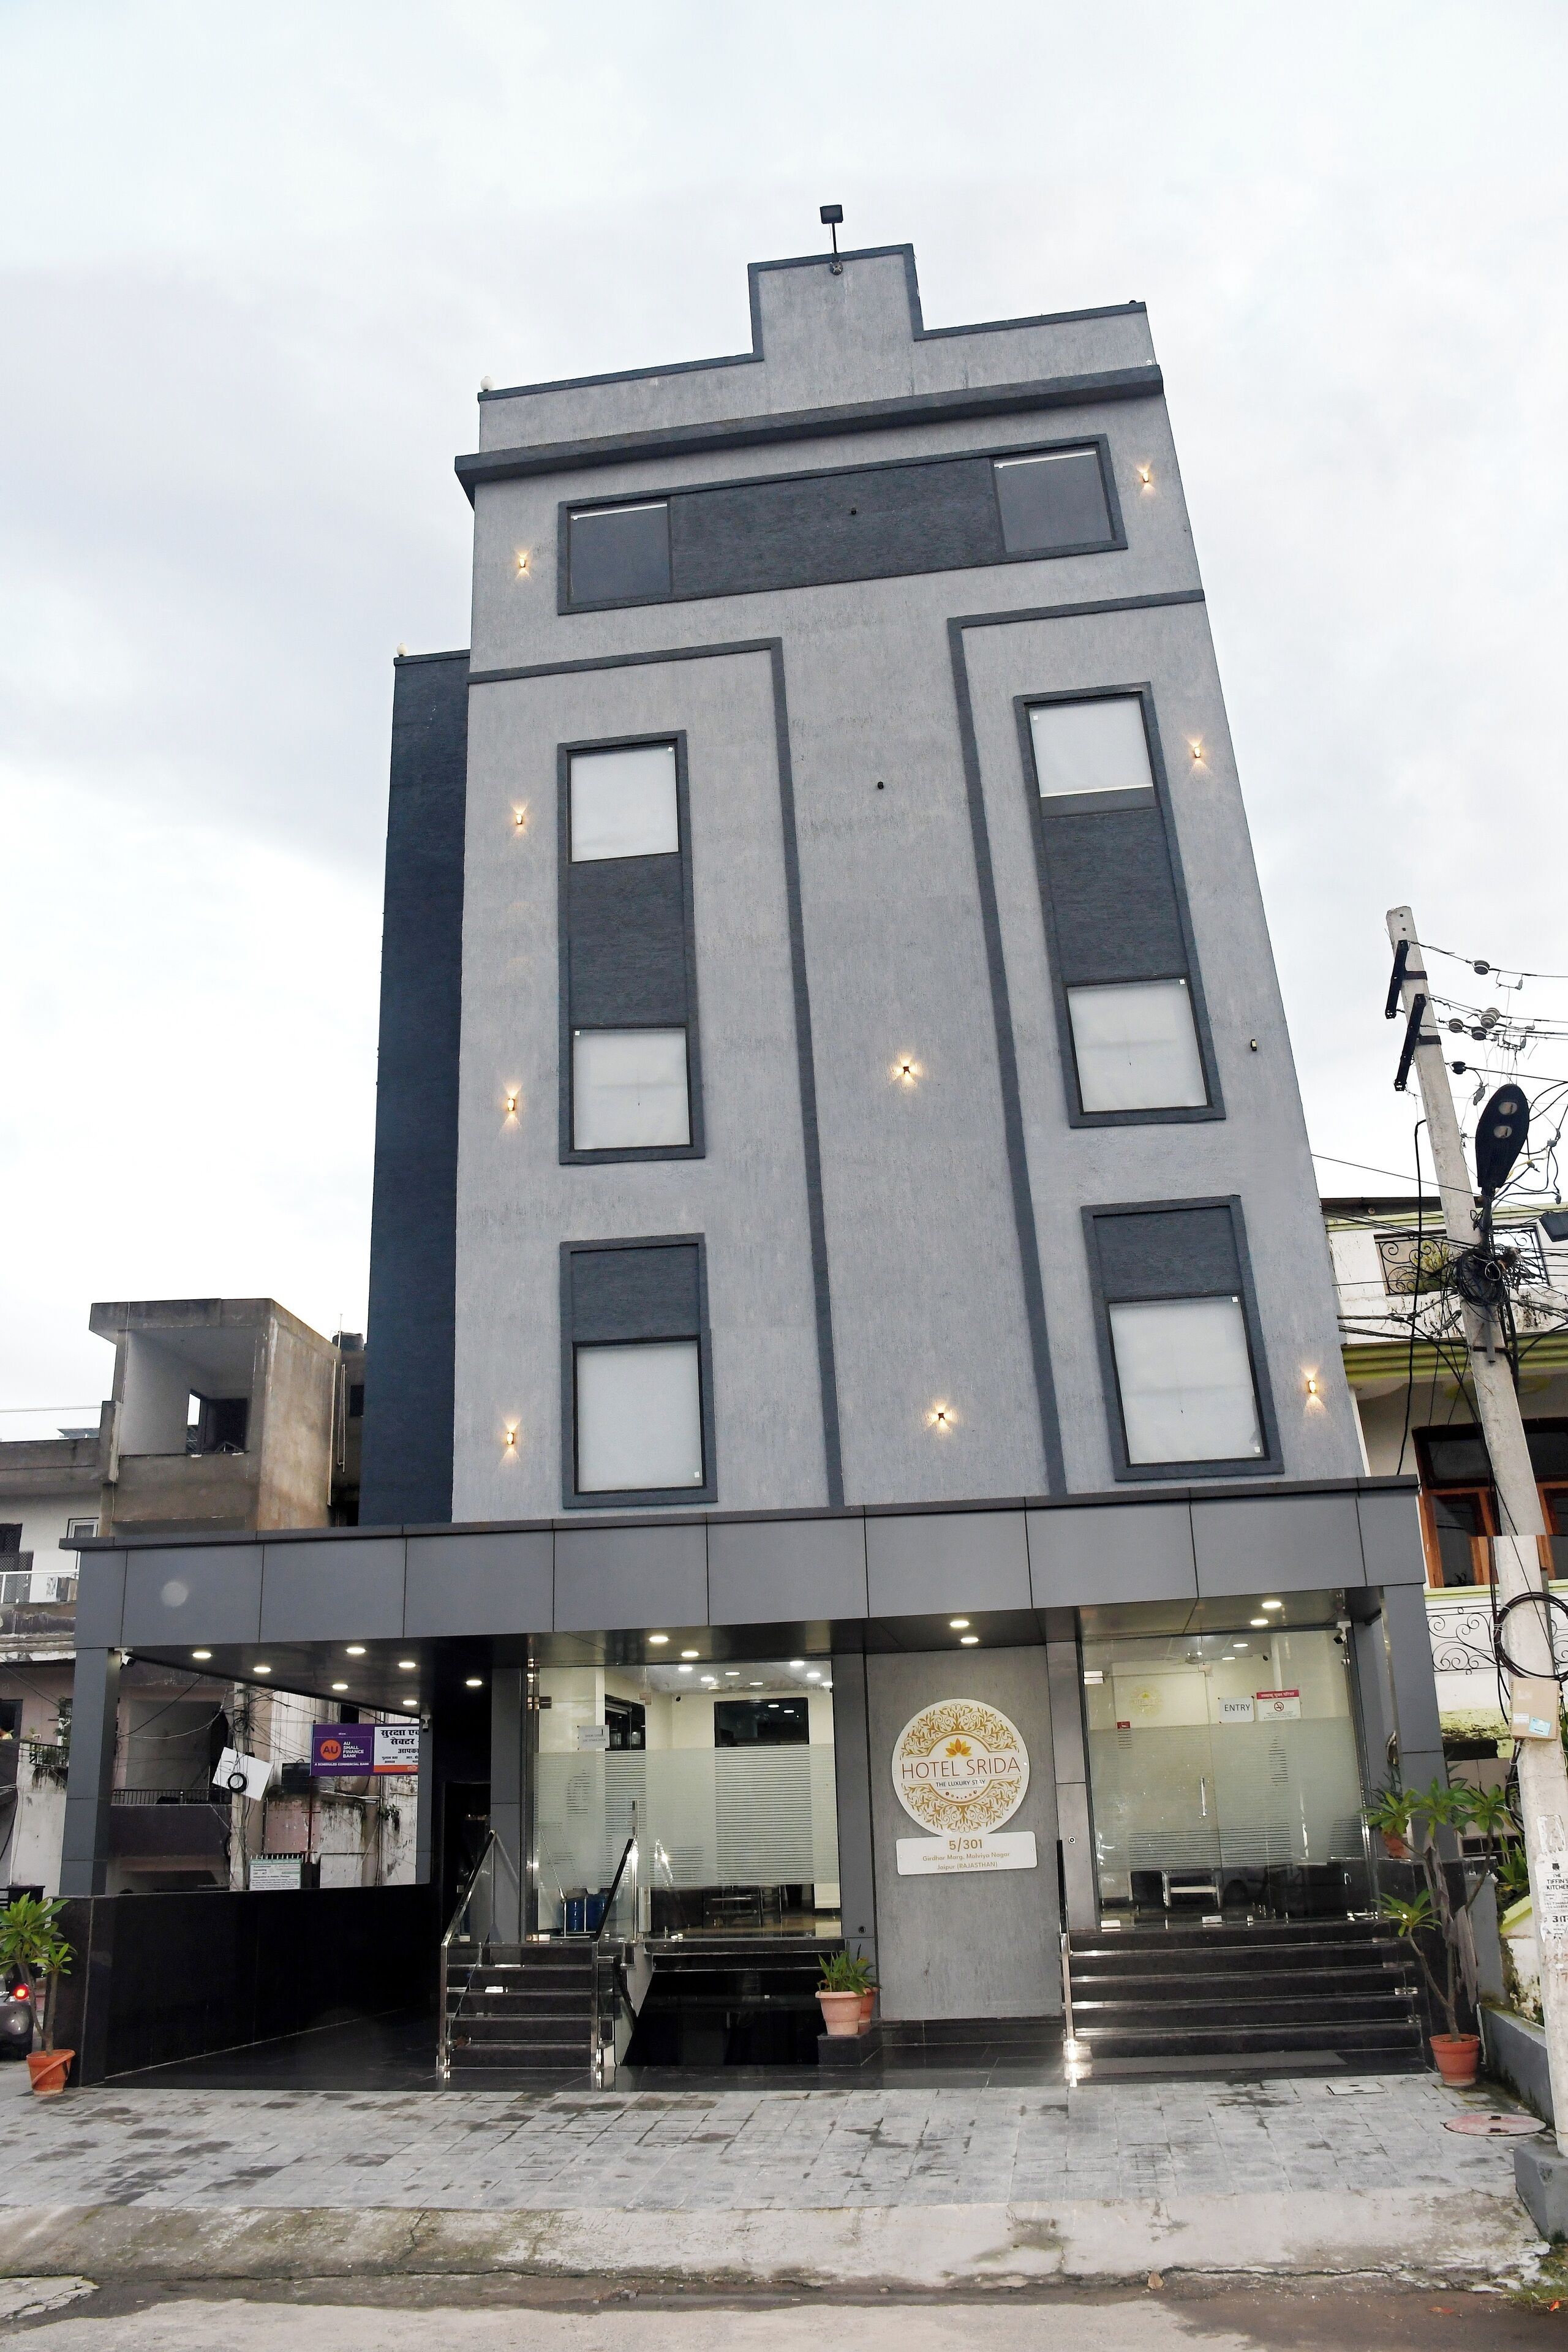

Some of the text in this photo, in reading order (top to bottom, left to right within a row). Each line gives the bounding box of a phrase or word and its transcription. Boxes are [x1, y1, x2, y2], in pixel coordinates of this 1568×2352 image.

[380, 1730, 406, 1738] सुरक्षा
[323, 1745, 338, 1754] AU
[902, 1757, 1021, 1779] HOTEL SRIDA
[949, 1838, 983, 1852] 5/301
[957, 1861, 998, 1870] (RAJASTHAN)
